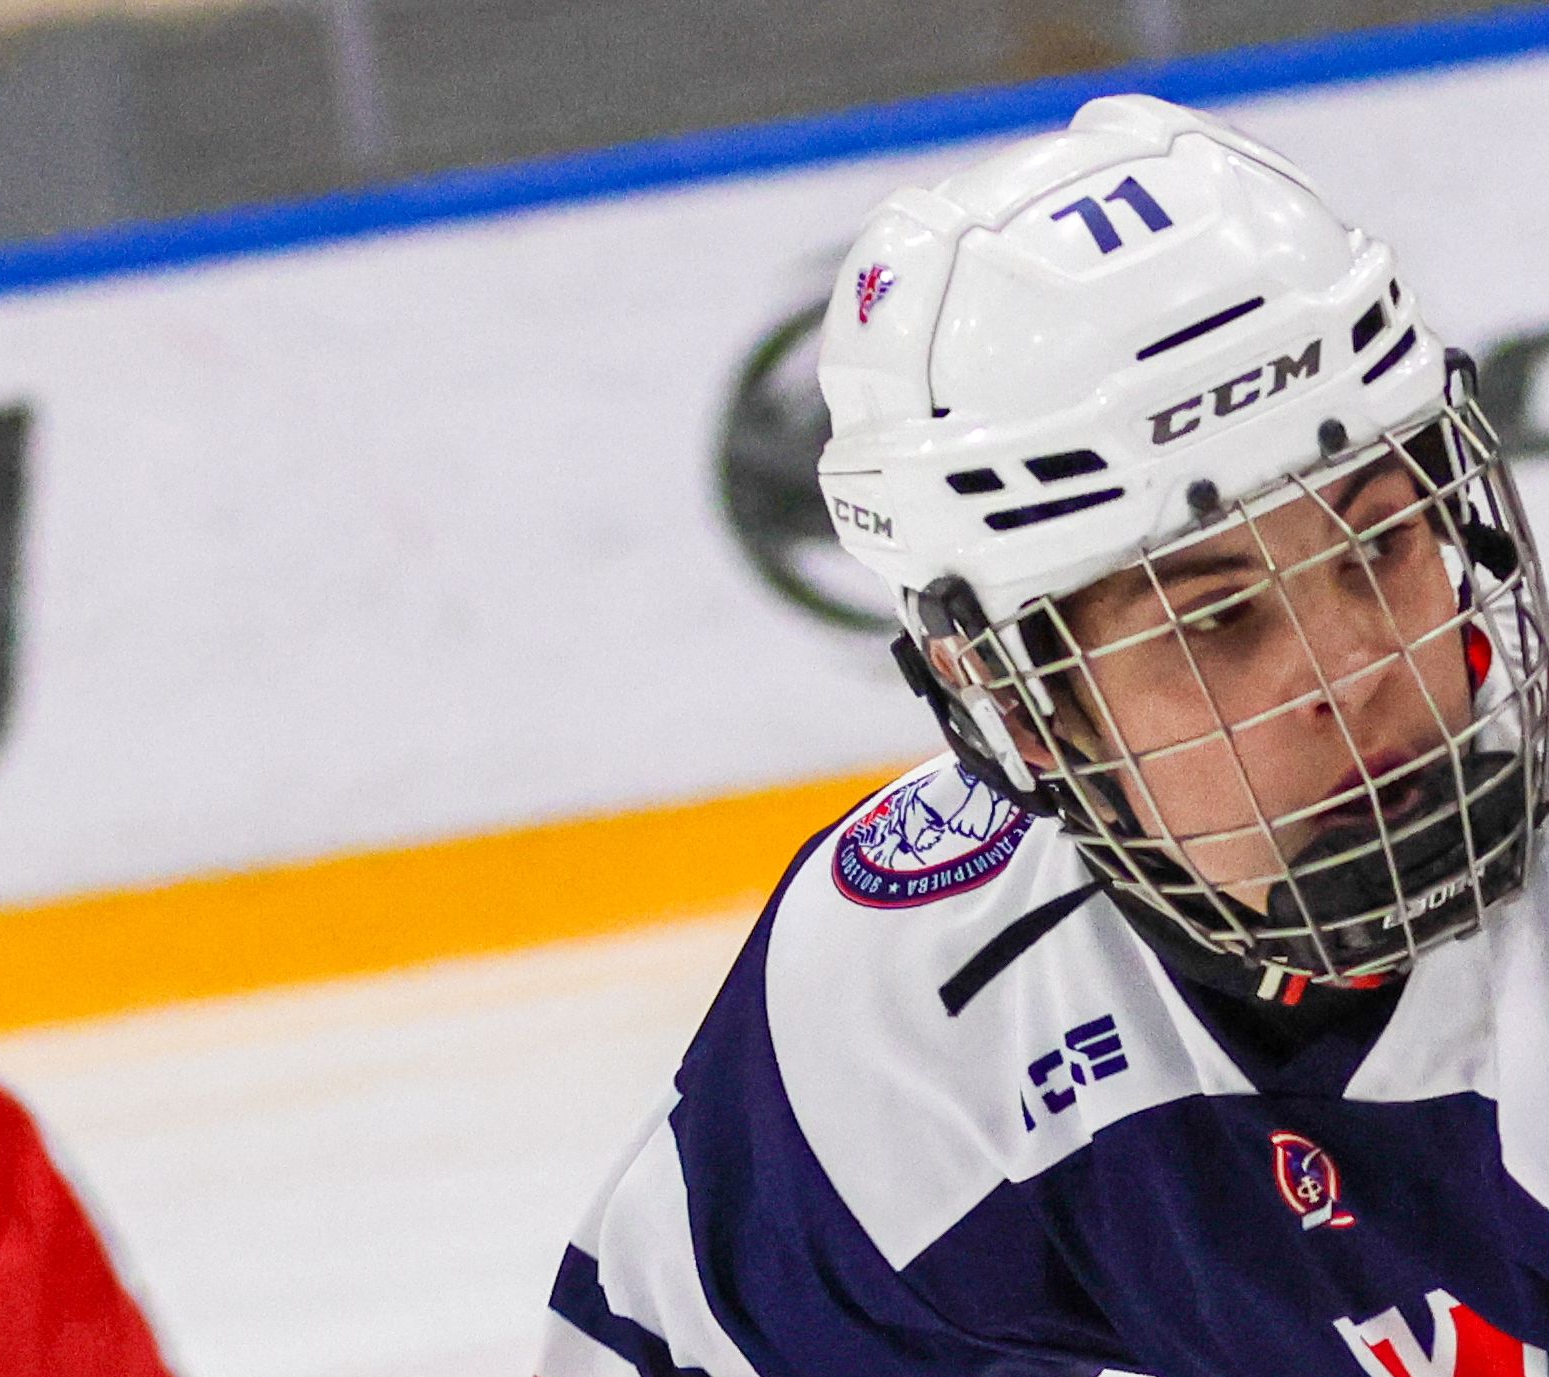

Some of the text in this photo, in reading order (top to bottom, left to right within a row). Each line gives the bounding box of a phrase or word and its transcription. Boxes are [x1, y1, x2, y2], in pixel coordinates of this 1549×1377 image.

[1051, 176, 1174, 255] 71
[1149, 338, 1323, 446] CCM
[832, 496, 894, 540] CCM
[907, 837, 1015, 896] ДМИТРИЕВА
